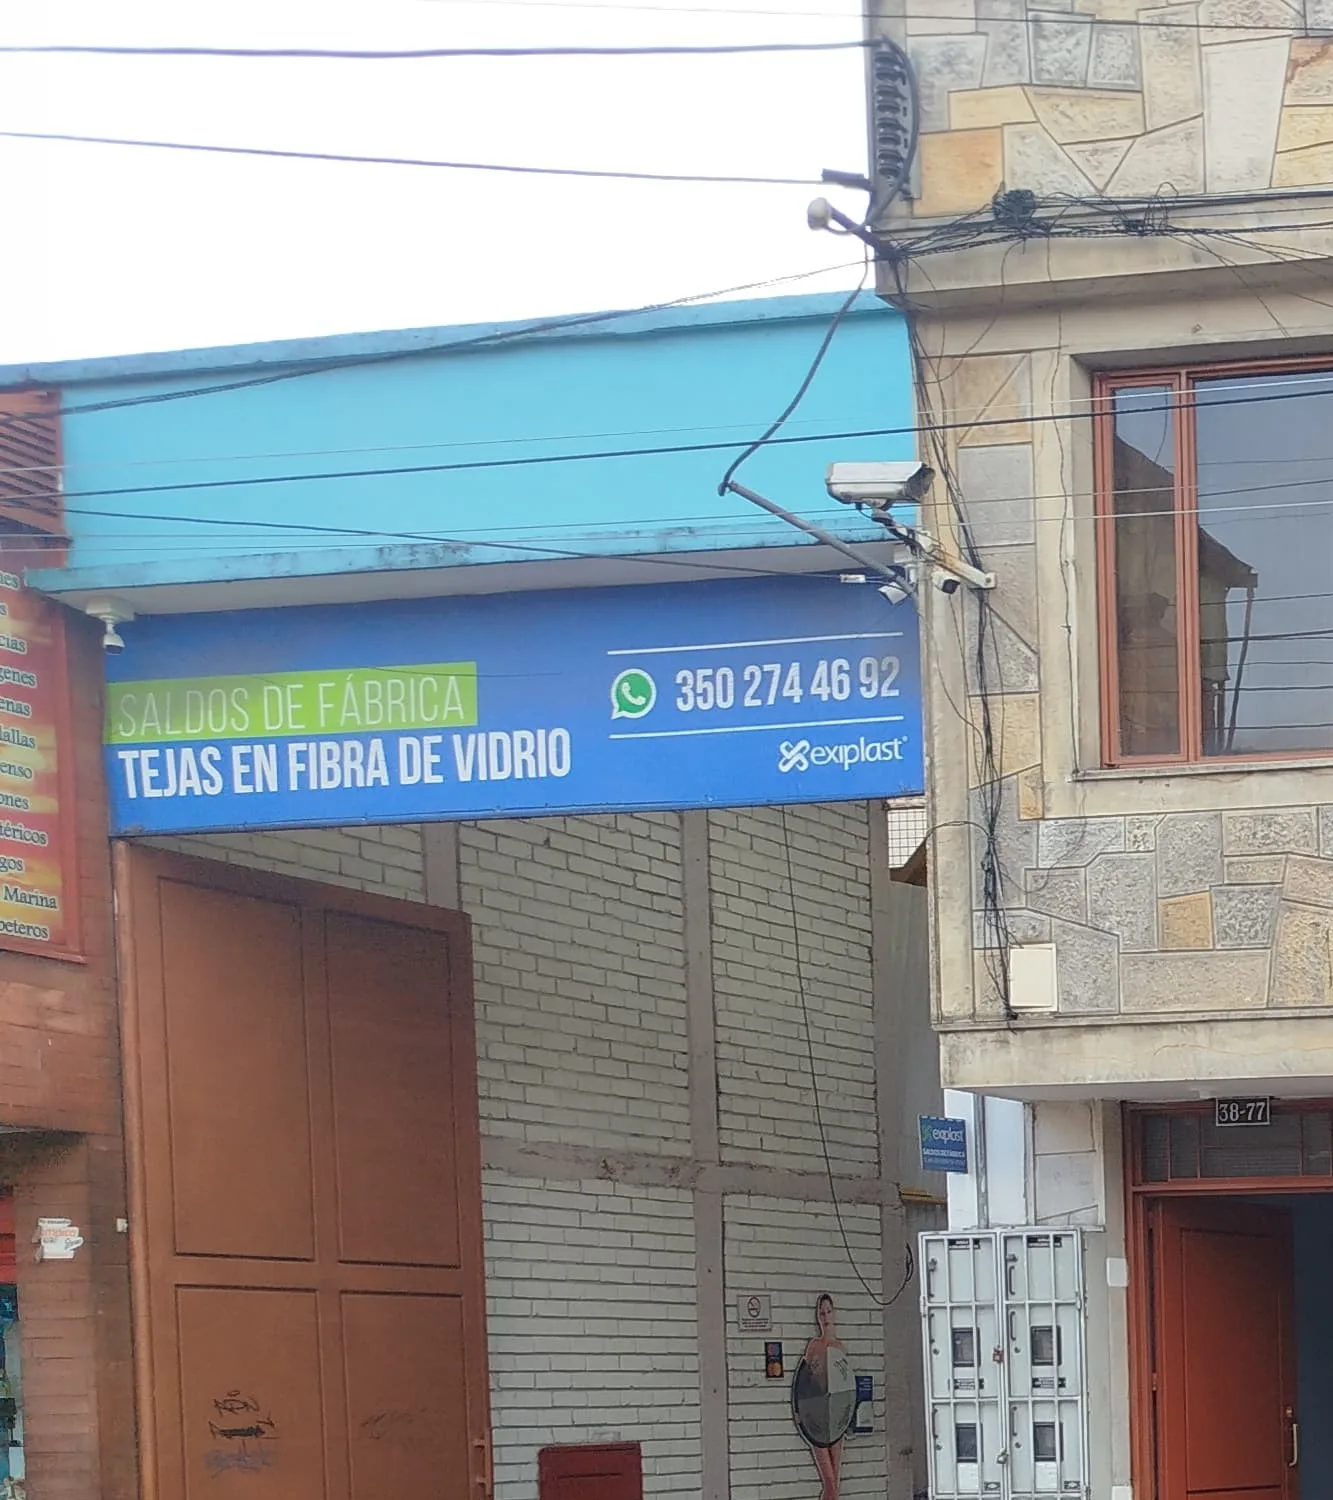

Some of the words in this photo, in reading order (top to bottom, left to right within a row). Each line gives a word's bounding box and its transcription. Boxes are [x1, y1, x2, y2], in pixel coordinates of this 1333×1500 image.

[119, 686, 250, 738] SALDOS
[263, 684, 306, 731] DE
[319, 674, 465, 728] FÁBRICA
[675, 667, 735, 712] 350
[743, 662, 803, 707] 274
[810, 658, 850, 702] 46
[859, 656, 900, 698] 92
[117, 745, 222, 799] TEJAS
[232, 744, 278, 793] EN
[288, 738, 389, 791] FIBRA
[400, 734, 444, 785] DE
[452, 728, 571, 782] VIDRIO
[810, 736, 904, 770] exiplast
[4, 886, 57, 909] Marina
[1219, 1102, 1266, 1122] 38-77
